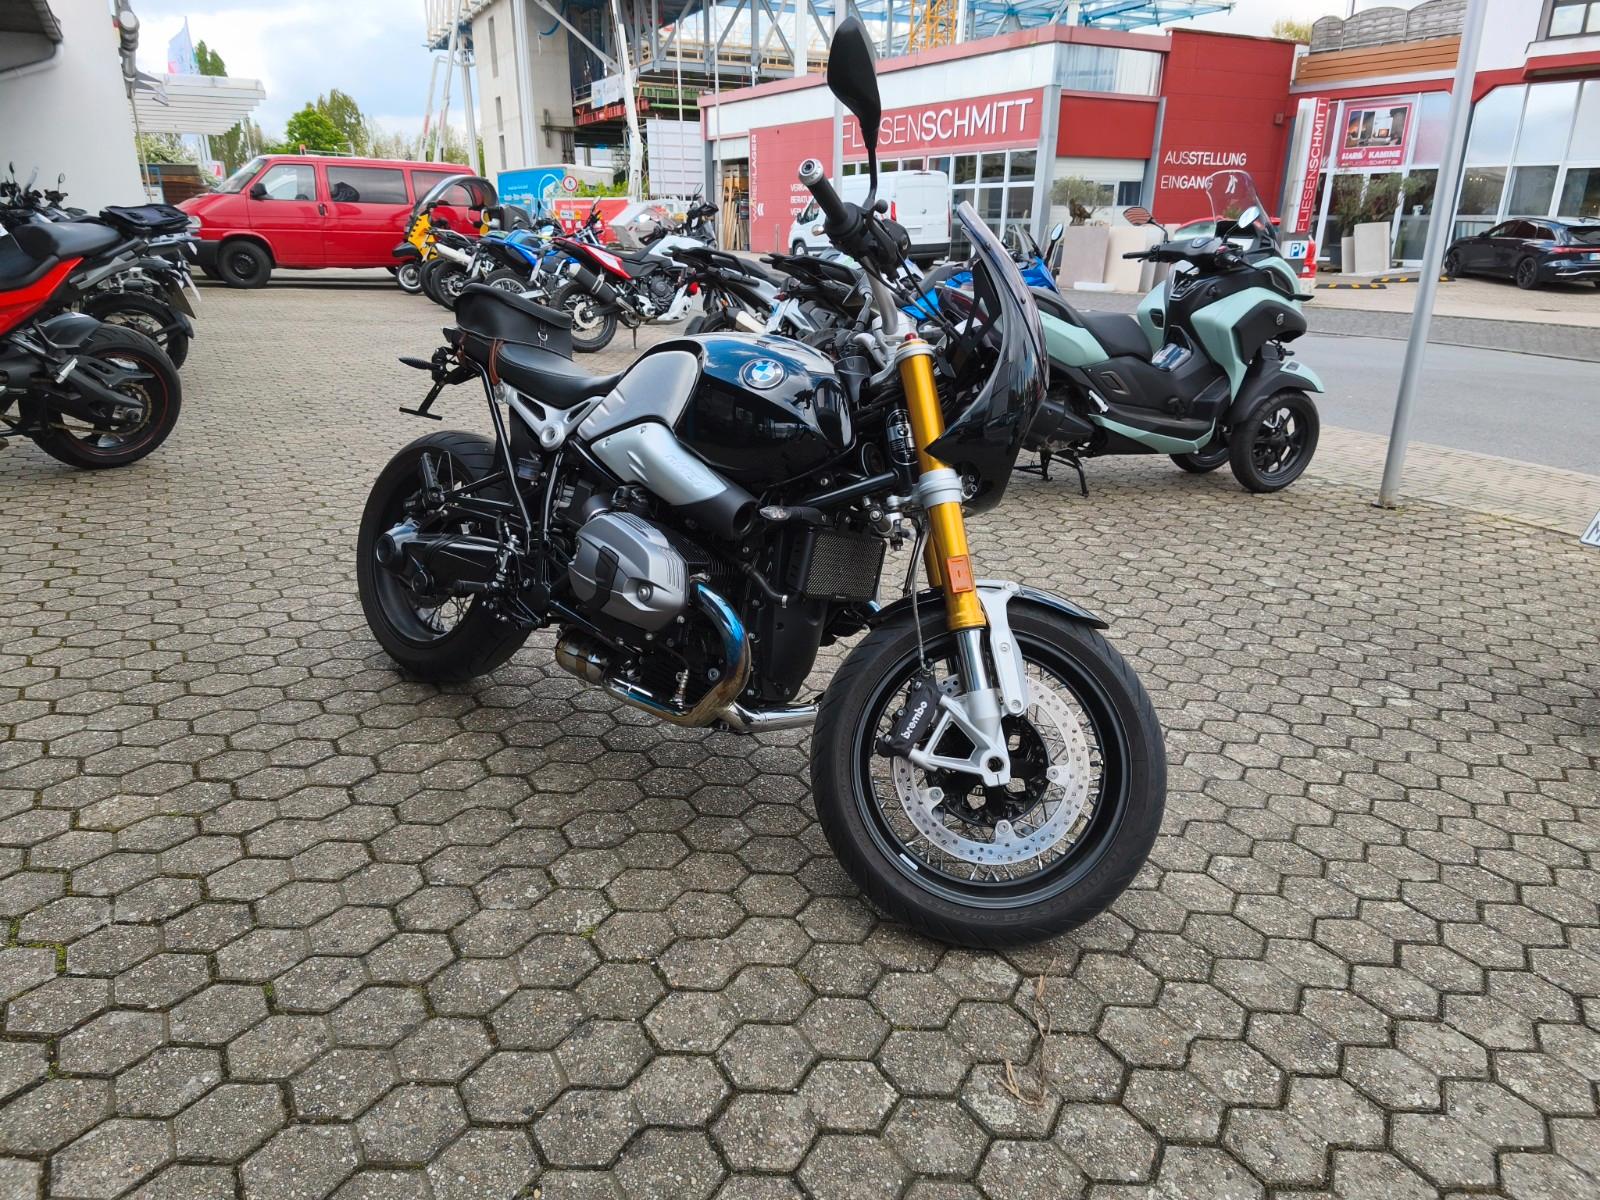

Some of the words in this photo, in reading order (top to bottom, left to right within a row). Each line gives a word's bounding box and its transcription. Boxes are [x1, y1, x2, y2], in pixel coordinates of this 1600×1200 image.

[842, 97, 1034, 148] FLSENSCHMITT
[1163, 151, 1248, 167] AUSSTELLUNG
[1297, 100, 1328, 232] FLIESENSCHMITT
[1160, 175, 1213, 190] EINGANG
[900, 701, 928, 740] brembo
